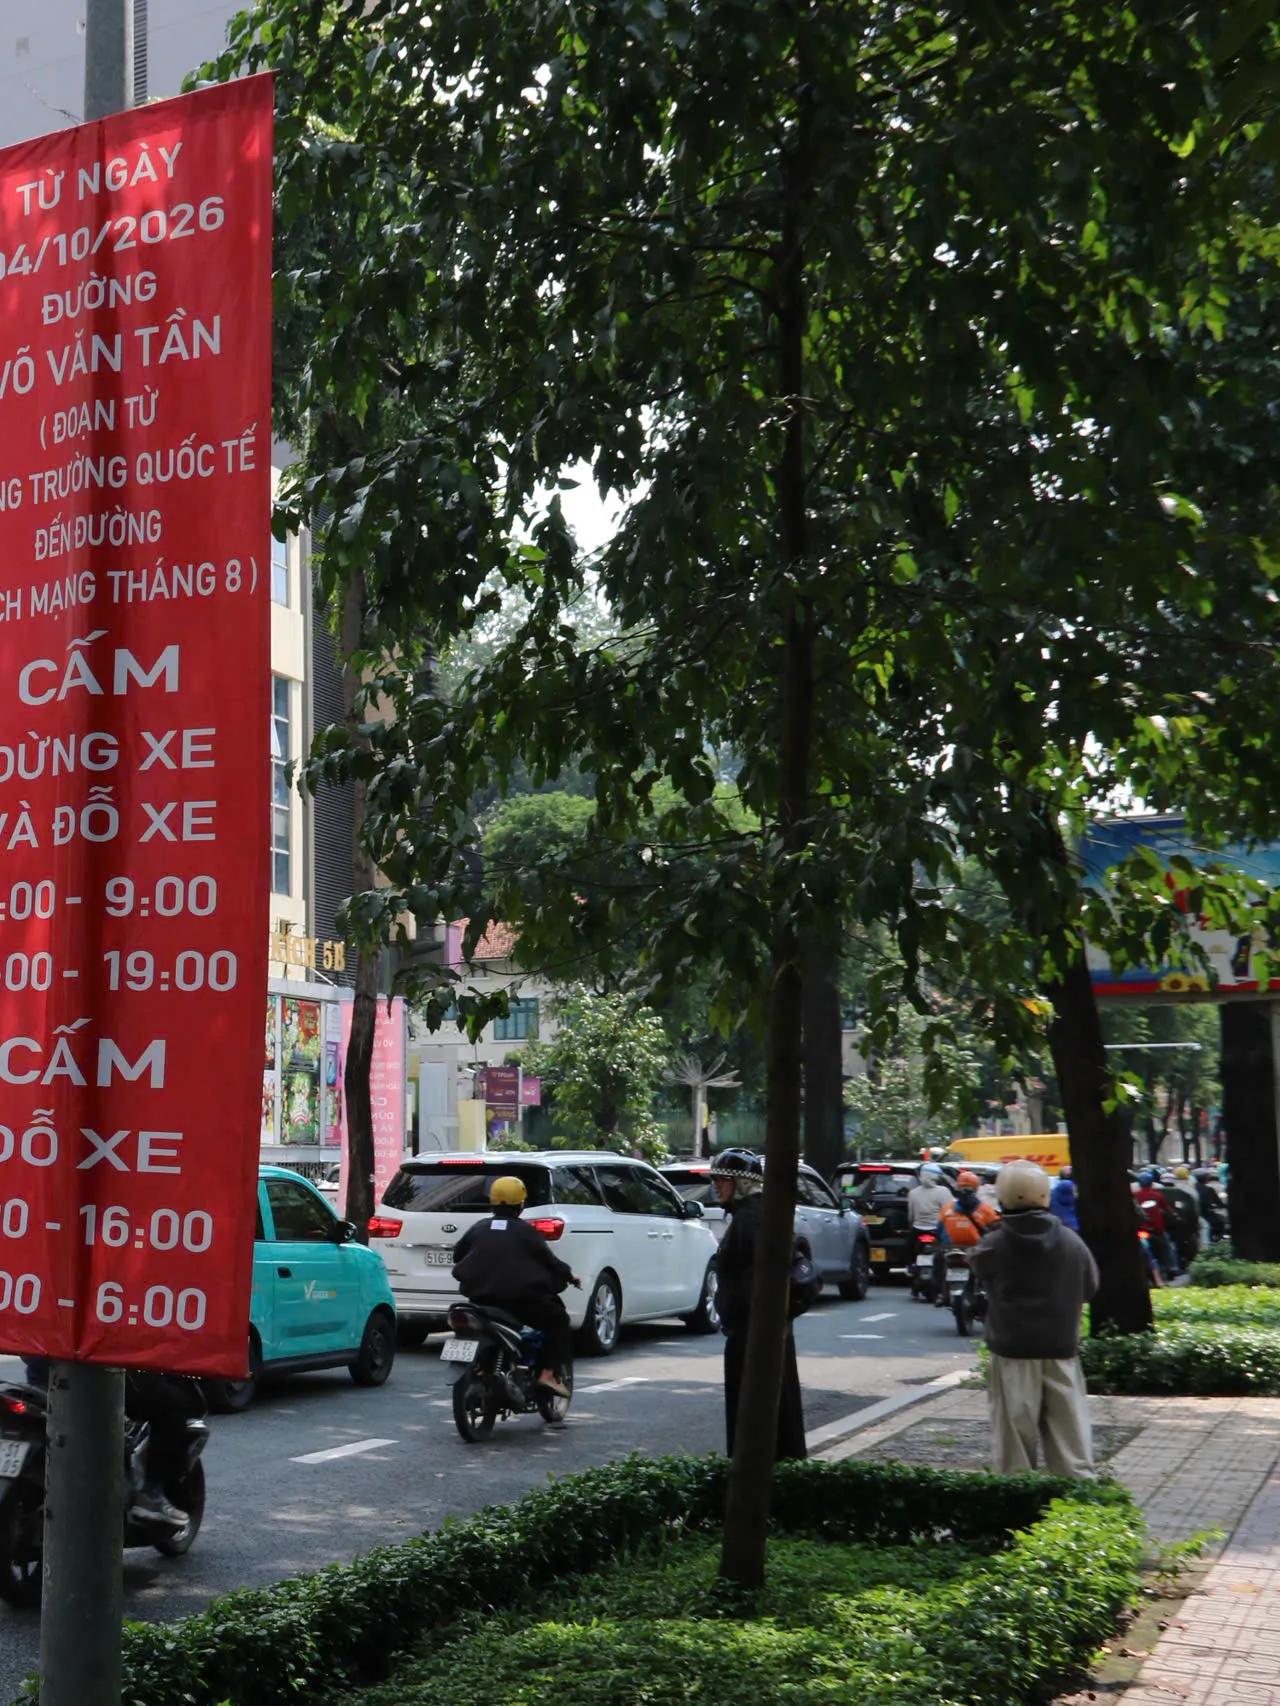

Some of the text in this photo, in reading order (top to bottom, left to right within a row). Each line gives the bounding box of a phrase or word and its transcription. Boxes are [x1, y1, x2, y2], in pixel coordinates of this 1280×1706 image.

[16, 141, 183, 216] TỪ NGÀY
[41, 270, 157, 325] ĐƯỜNG
[46, 328, 122, 386] VĂN
[134, 307, 221, 367] TẦN
[123, 384, 159, 429] TỪ
[28, 453, 127, 504] TRƯỜNG
[135, 432, 215, 485] QUỐC
[221, 422, 258, 473] TẾ
[34, 505, 162, 561] ĐẾN ĐƯỜNG
[30, 570, 96, 622] MẠNG
[107, 557, 216, 604] THÁNG
[18, 630, 180, 706] CẤM
[138, 727, 216, 771] XE
[51, 786, 119, 846] ĐỖ
[138, 800, 217, 843] XE
[105, 875, 217, 917] 9:00
[103, 950, 237, 992] 19:00
[323, 940, 346, 972] 5B
[76, 1129, 183, 1174] XE
[80, 1205, 213, 1253] 16:00
[95, 1281, 207, 1331] 6:00
